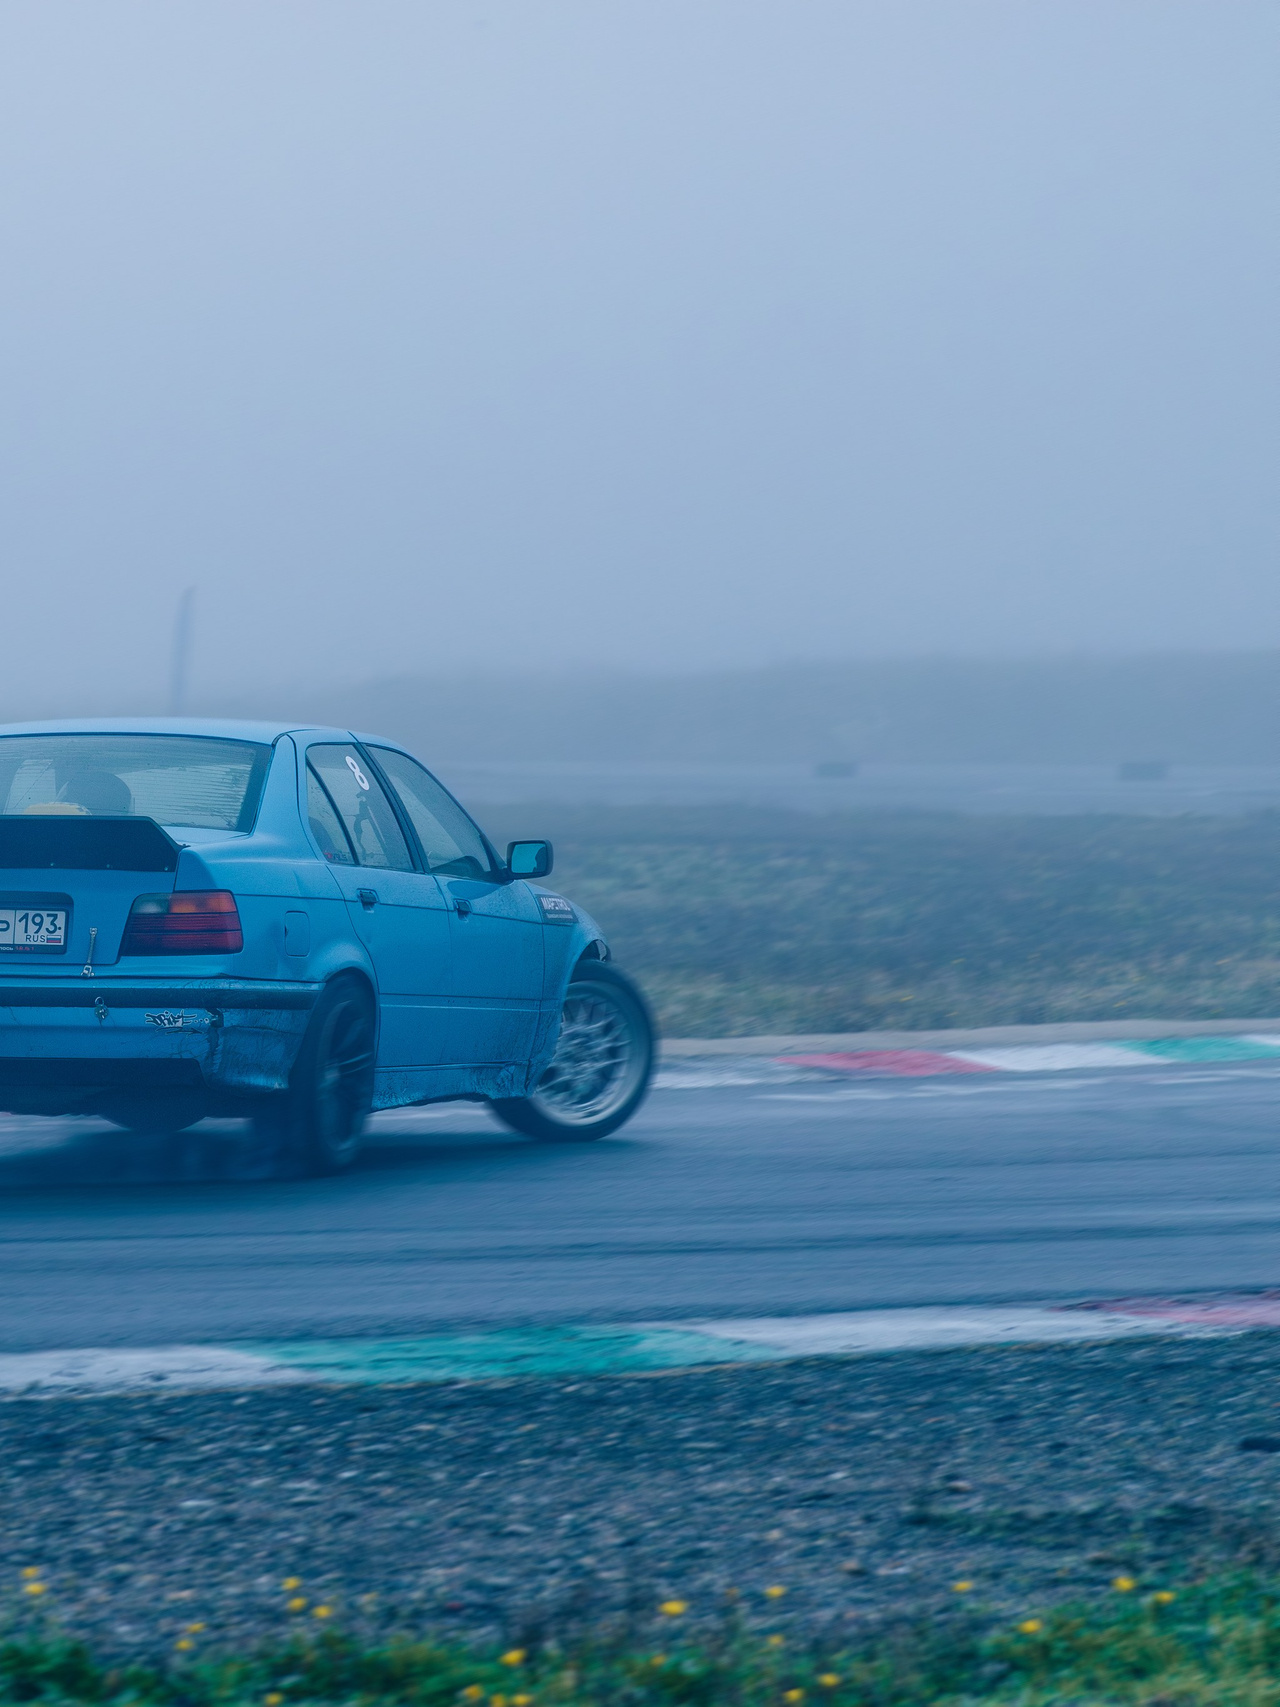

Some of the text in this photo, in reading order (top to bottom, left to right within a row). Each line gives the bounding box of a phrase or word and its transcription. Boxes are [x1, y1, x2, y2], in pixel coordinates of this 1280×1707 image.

[345, 755, 370, 791] 8
[18, 912, 59, 935] 193
[25, 934, 46, 943] RUS
